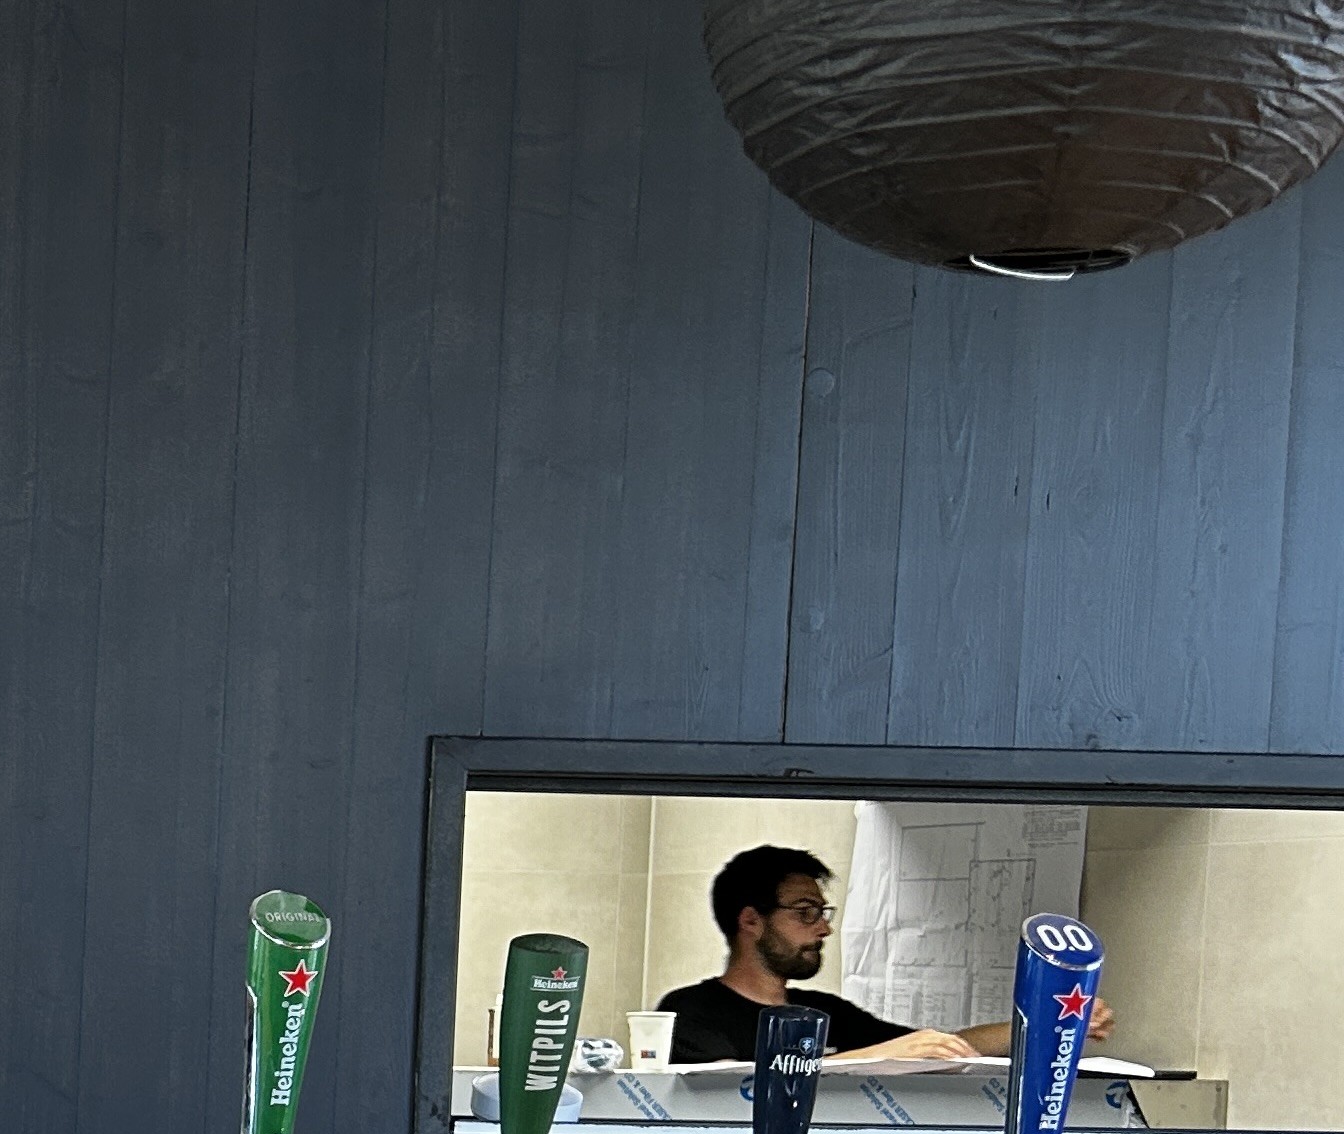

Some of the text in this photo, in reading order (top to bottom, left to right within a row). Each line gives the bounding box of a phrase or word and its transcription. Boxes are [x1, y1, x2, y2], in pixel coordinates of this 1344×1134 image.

[265, 912, 321, 922] ORIGINAL
[1036, 924, 1094, 951] 0.0
[533, 979, 578, 989] Heineken
[270, 1003, 305, 1105] Heineken
[524, 1000, 571, 1091] WITPILS
[1038, 1027, 1076, 1130] Heineken
